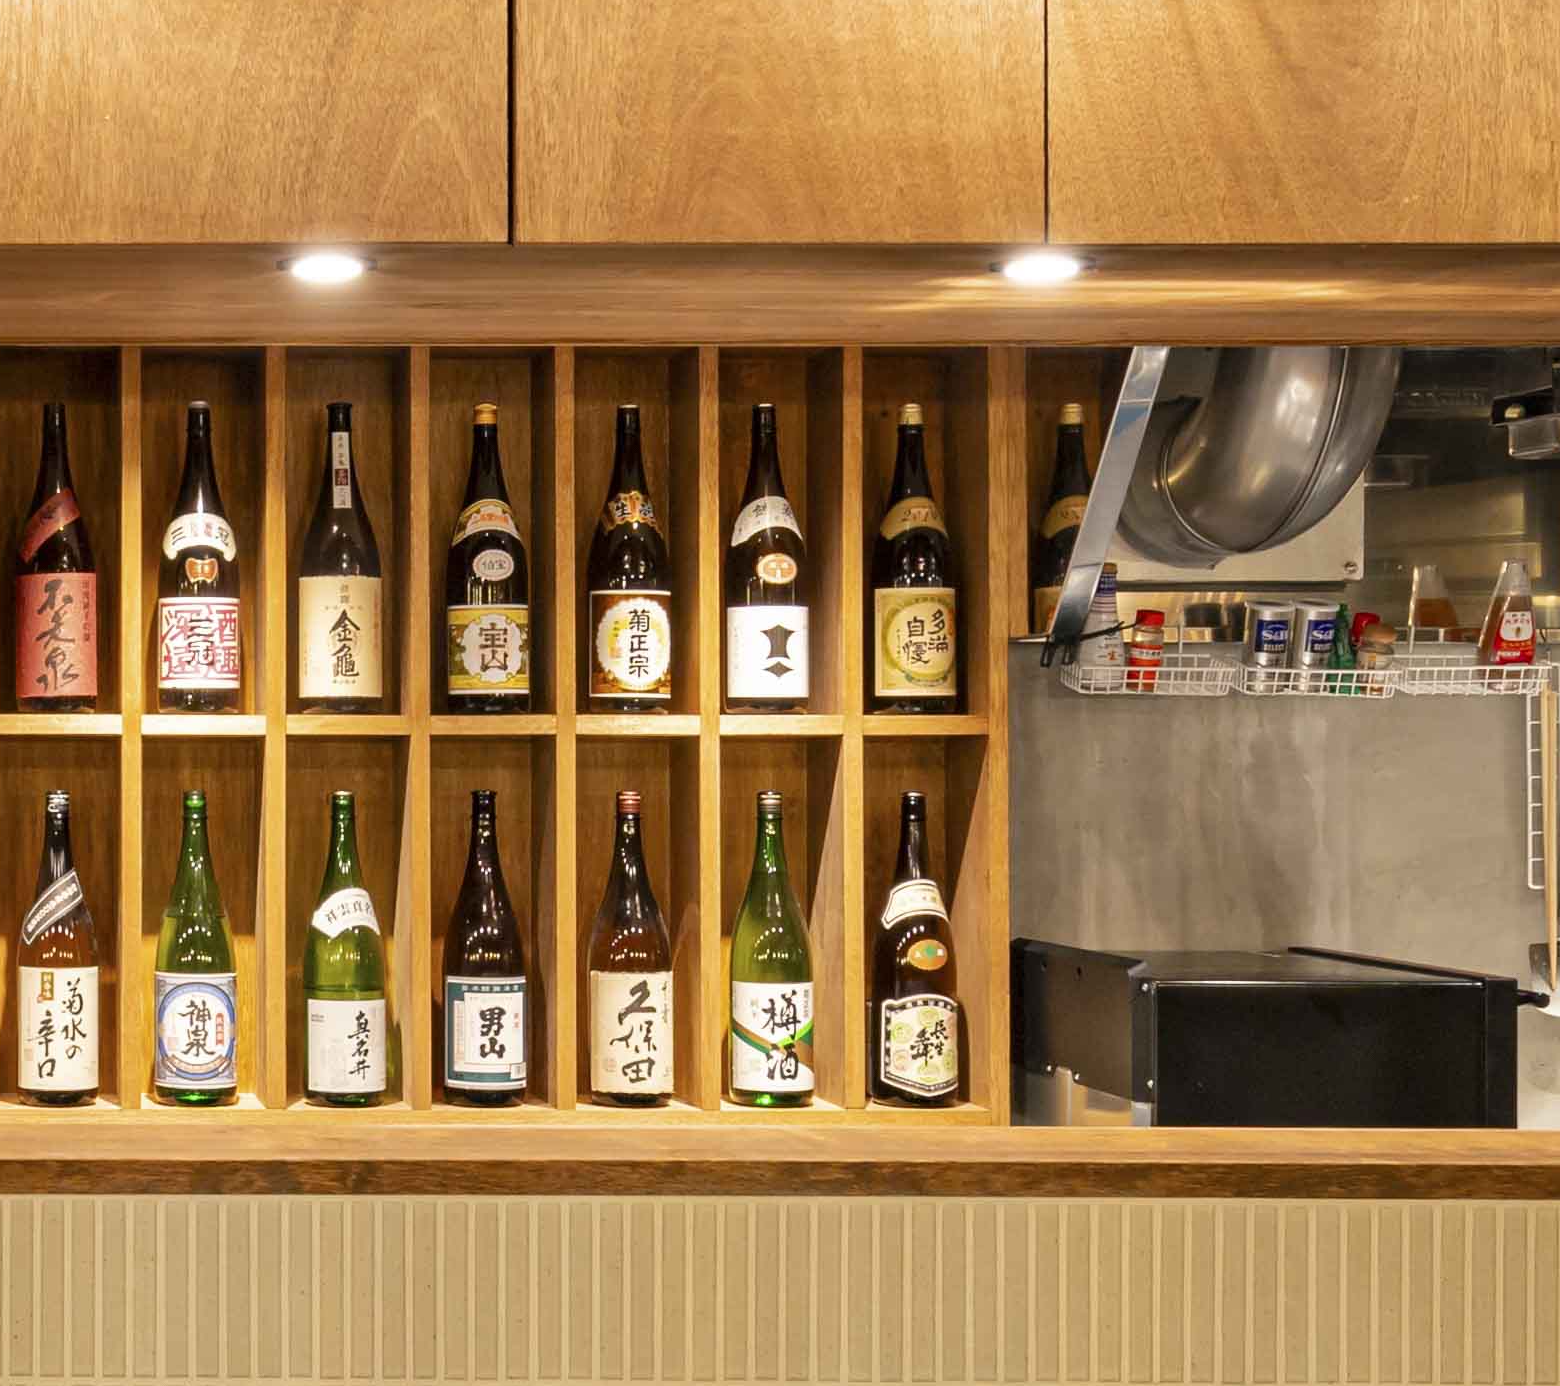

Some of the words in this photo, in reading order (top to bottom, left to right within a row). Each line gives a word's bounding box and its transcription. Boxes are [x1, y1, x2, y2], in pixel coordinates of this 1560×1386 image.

[478, 622, 509, 673] 宝山
[627, 607, 650, 678] 菊正宗
[31, 1009, 57, 1079] 辛口
[60, 977, 88, 1060] 菊水の
[479, 1006, 507, 1060] 男山
[609, 979, 658, 1084] 久保田
[760, 989, 802, 1081] 樽酒
